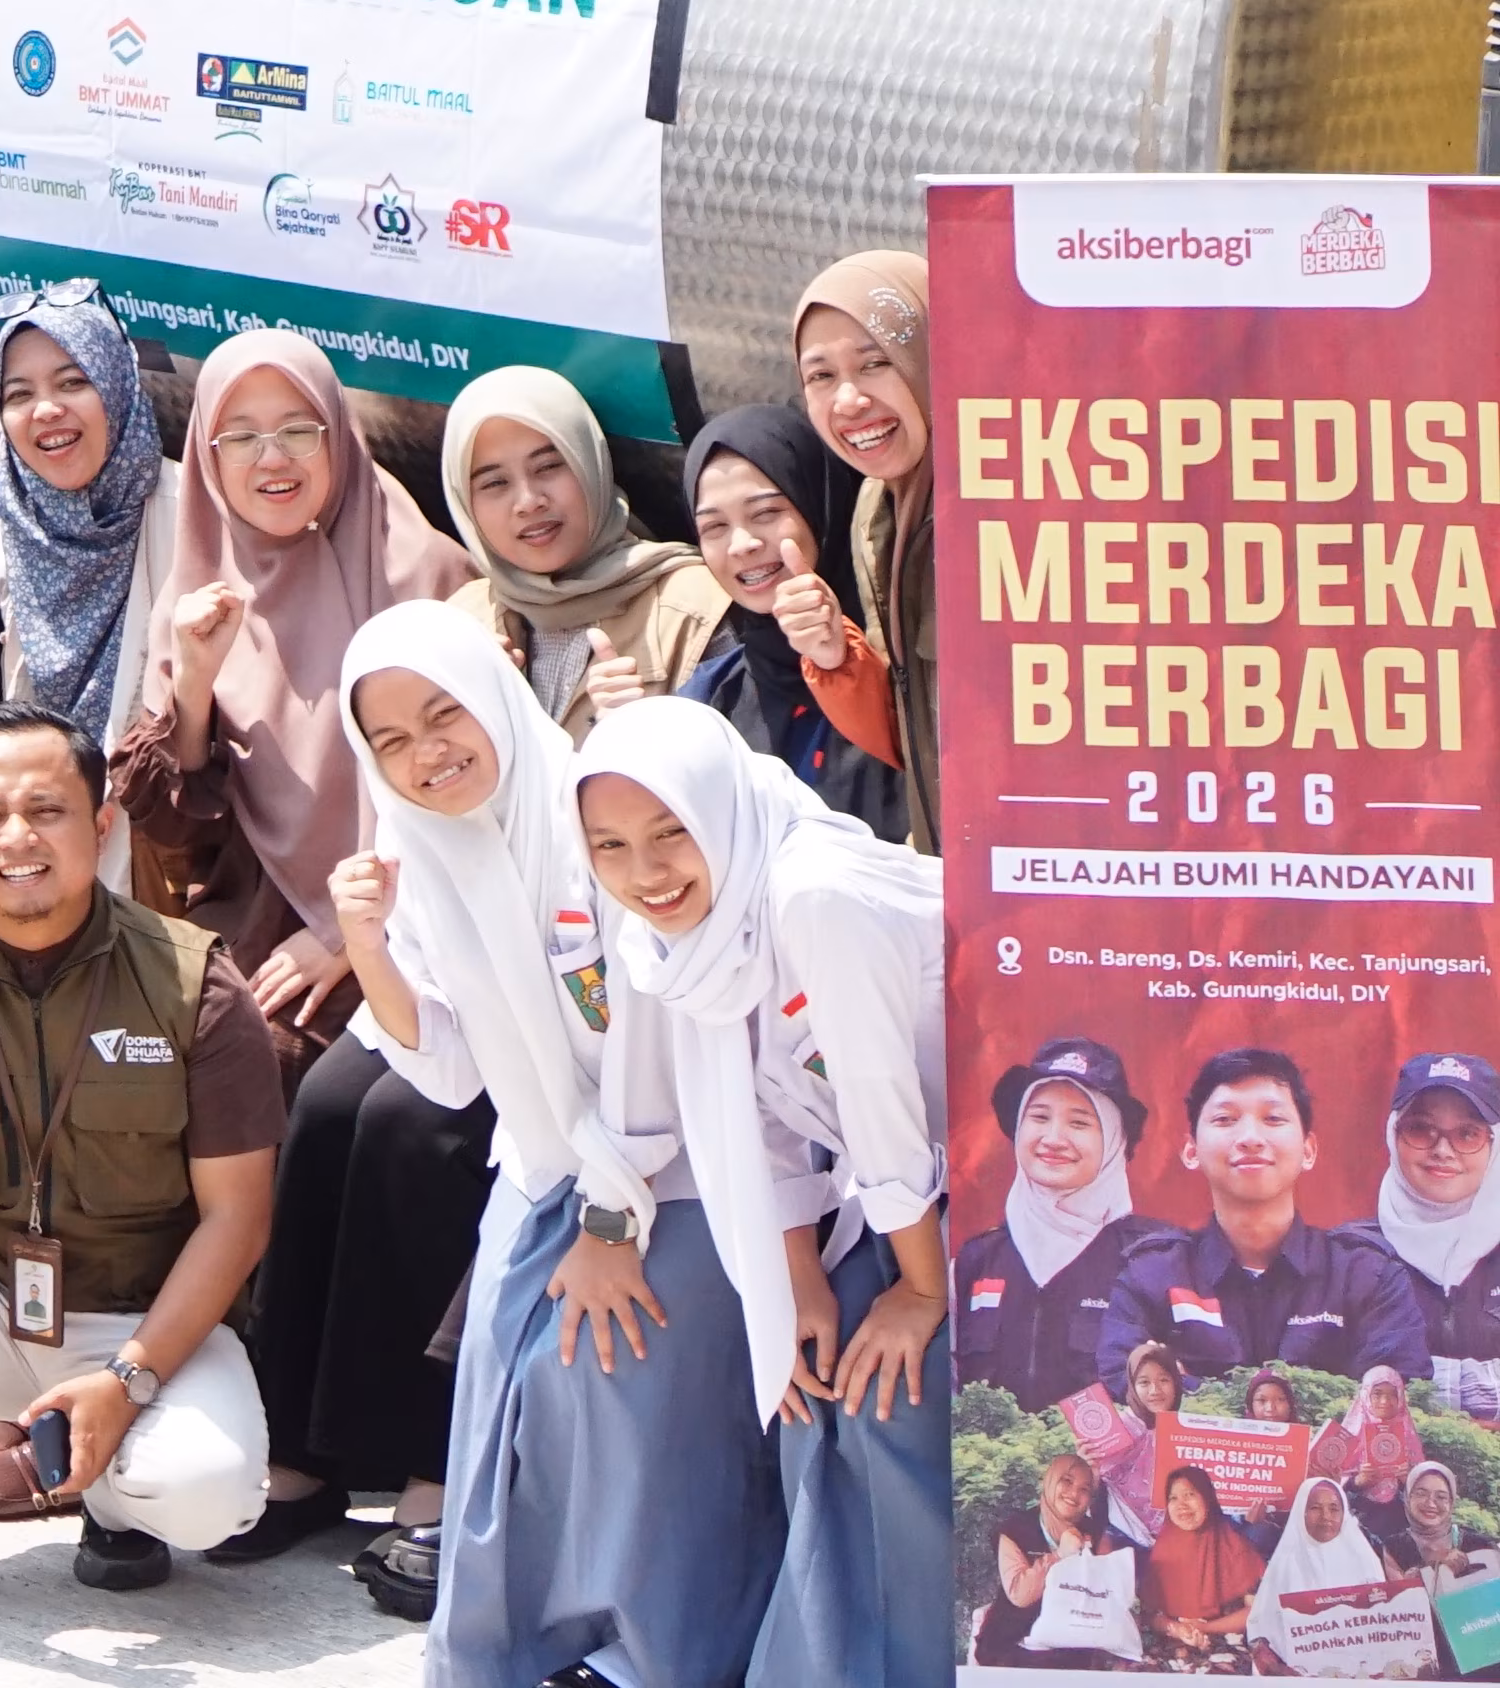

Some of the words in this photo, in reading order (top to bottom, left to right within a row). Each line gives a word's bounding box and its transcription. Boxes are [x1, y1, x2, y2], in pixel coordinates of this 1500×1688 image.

[257, 64, 307, 91] ArMina
[78, 85, 110, 107] BMT
[114, 89, 171, 113] UMMAT
[366, 80, 421, 107] BAITUL
[138, 161, 185, 177] KOPERASI
[30, 179, 88, 202] ummah
[158, 181, 186, 206] Tani
[188, 185, 239, 213] Mandiri
[274, 204, 299, 220] Bina
[299, 208, 342, 227] Qoryati
[275, 218, 328, 238] Sejahtera
[1056, 227, 1253, 267] aksiberbagi
[1300, 228, 1386, 256] MERDEKA
[1301, 250, 1387, 276] BERBAGI
[431, 343, 471, 371] DIY
[957, 397, 1500, 504] EKSPEDISI
[977, 519, 1497, 628] MERDEKA
[1011, 642, 1463, 752] BERBAGI
[1126, 769, 1335, 826] 2026
[1011, 857, 1161, 887] JELAJAH
[1173, 861, 1259, 887] BUMI
[1270, 863, 1476, 892] HANDAYANI
[1047, 945, 1094, 966] Dsn.
[1100, 948, 1183, 972] Bareng,
[1187, 949, 1223, 969] Ds.
[1228, 950, 1304, 973] Kemiri,
[1309, 952, 1355, 972] Kec.
[1360, 953, 1492, 977] Tanjungsari,
[1147, 979, 1197, 999] Kab.
[1202, 980, 1345, 1004] Gunungkidul,
[1350, 982, 1391, 1003] DIY
[125, 1047, 174, 1058] DHUAFA
[1175, 1445, 1227, 1464] TEBAR
[1227, 1450, 1287, 1469] SEJUTA
[1290, 1619, 1340, 1638] SEMOGA
[1294, 1635, 1365, 1655] MUDAHKAN
